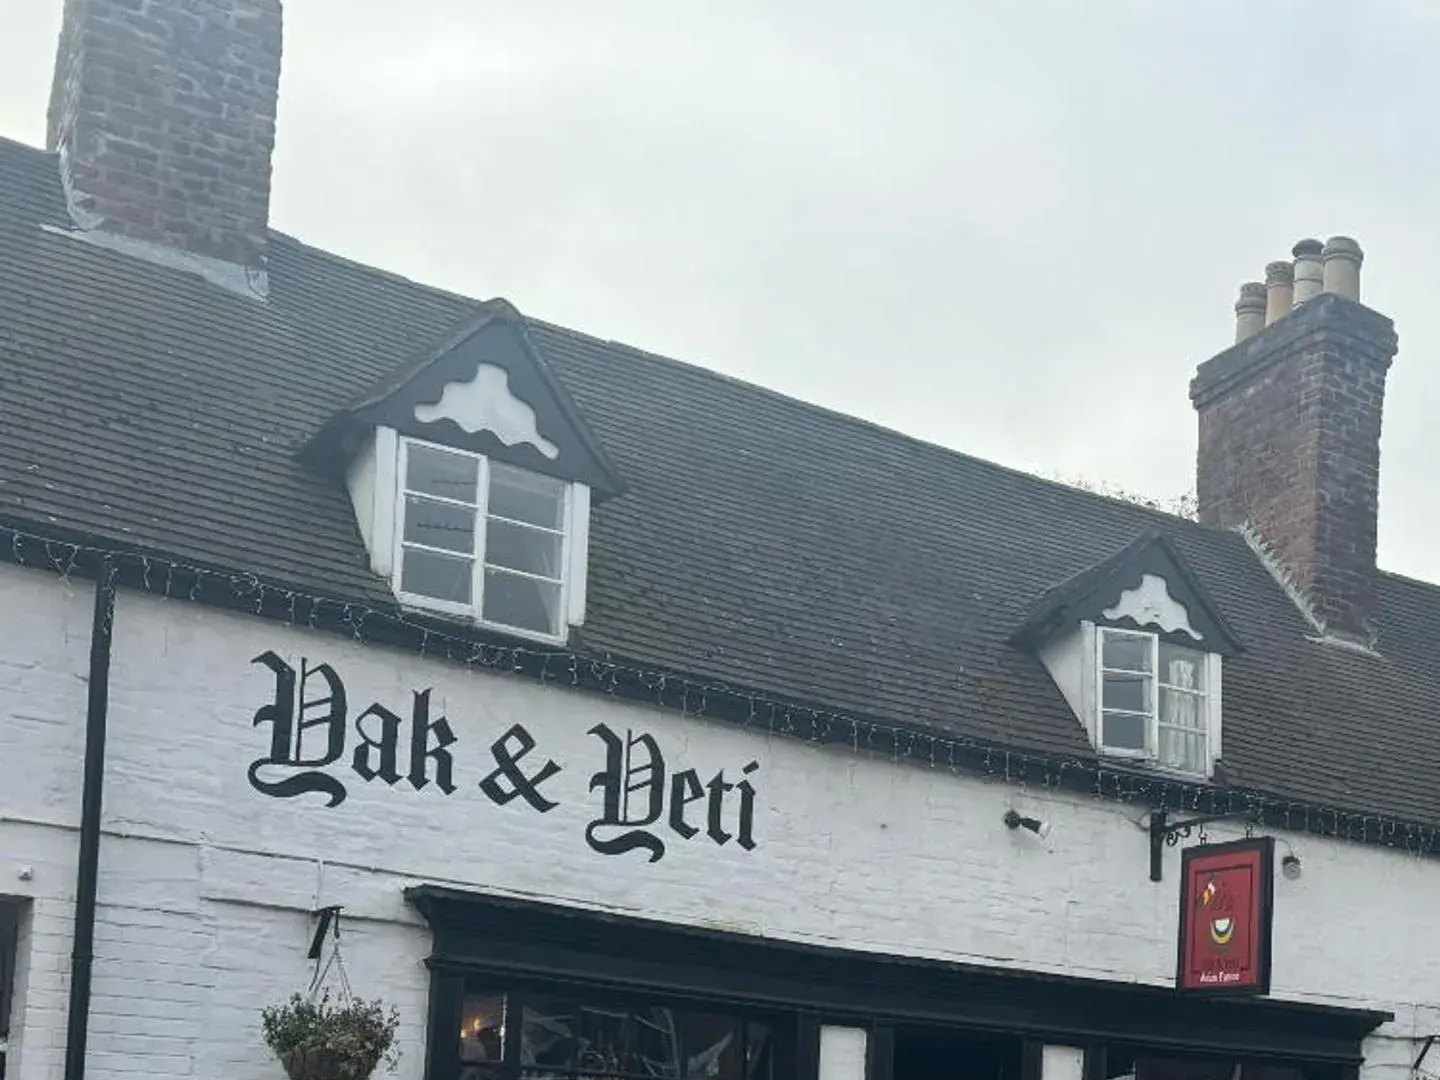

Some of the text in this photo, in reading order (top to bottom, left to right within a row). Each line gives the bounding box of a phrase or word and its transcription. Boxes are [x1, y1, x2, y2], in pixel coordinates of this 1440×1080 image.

[247, 649, 760, 863] Yak & Yeti
